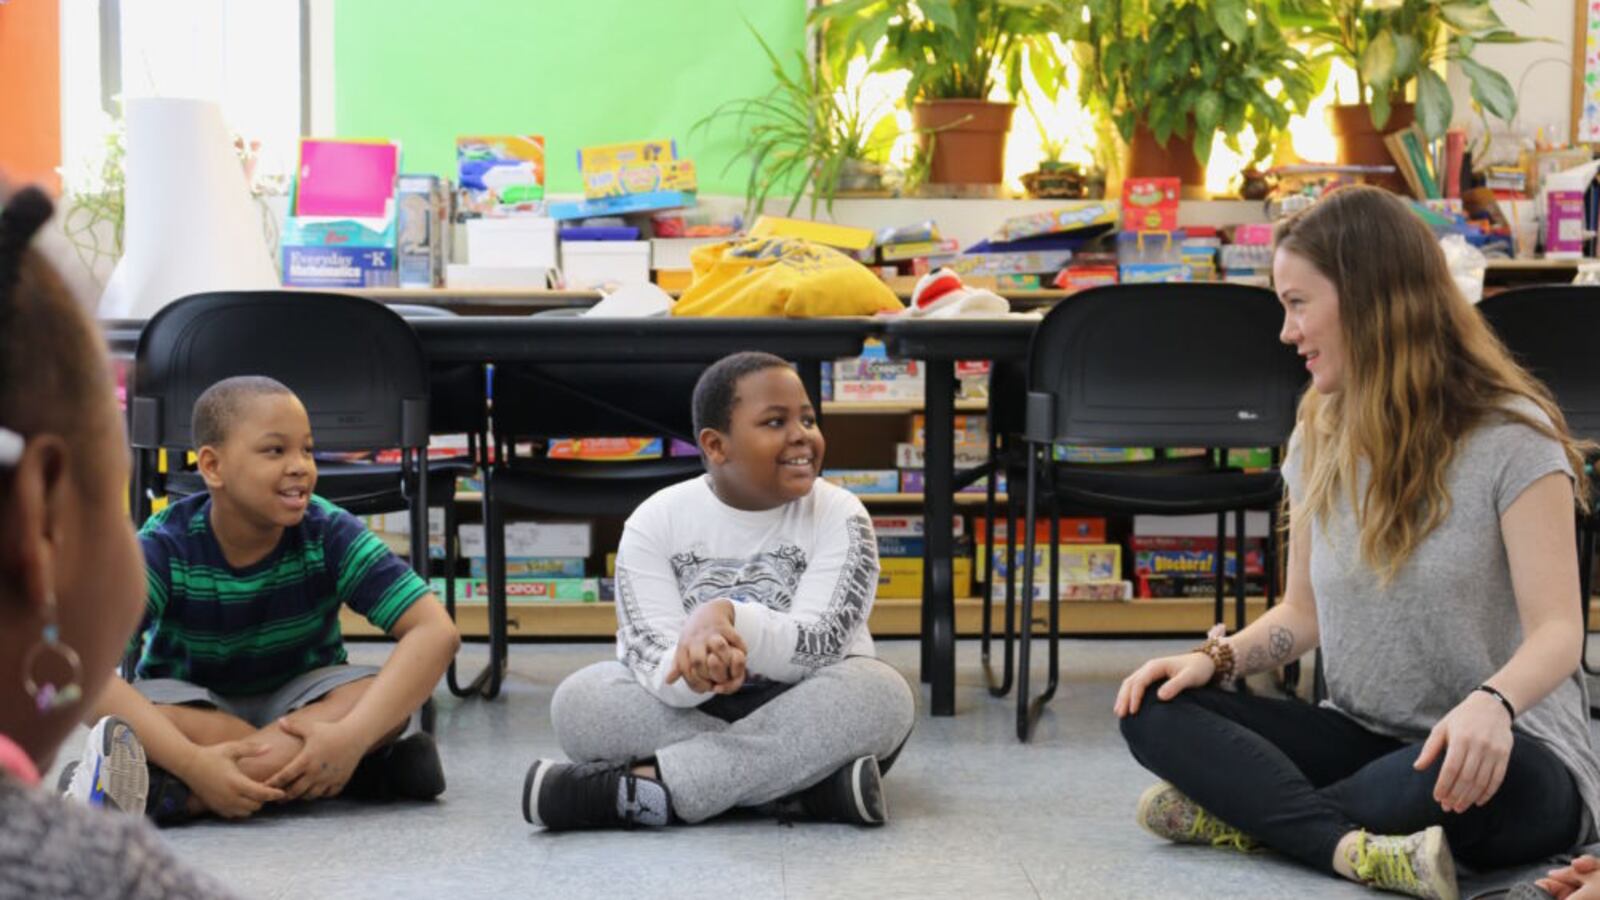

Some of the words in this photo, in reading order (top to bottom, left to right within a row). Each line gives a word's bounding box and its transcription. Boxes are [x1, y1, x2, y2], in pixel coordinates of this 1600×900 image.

[290, 251, 354, 269] Everyday
[290, 266, 361, 277] Mathematics
[480, 583, 545, 595] OPOLY
